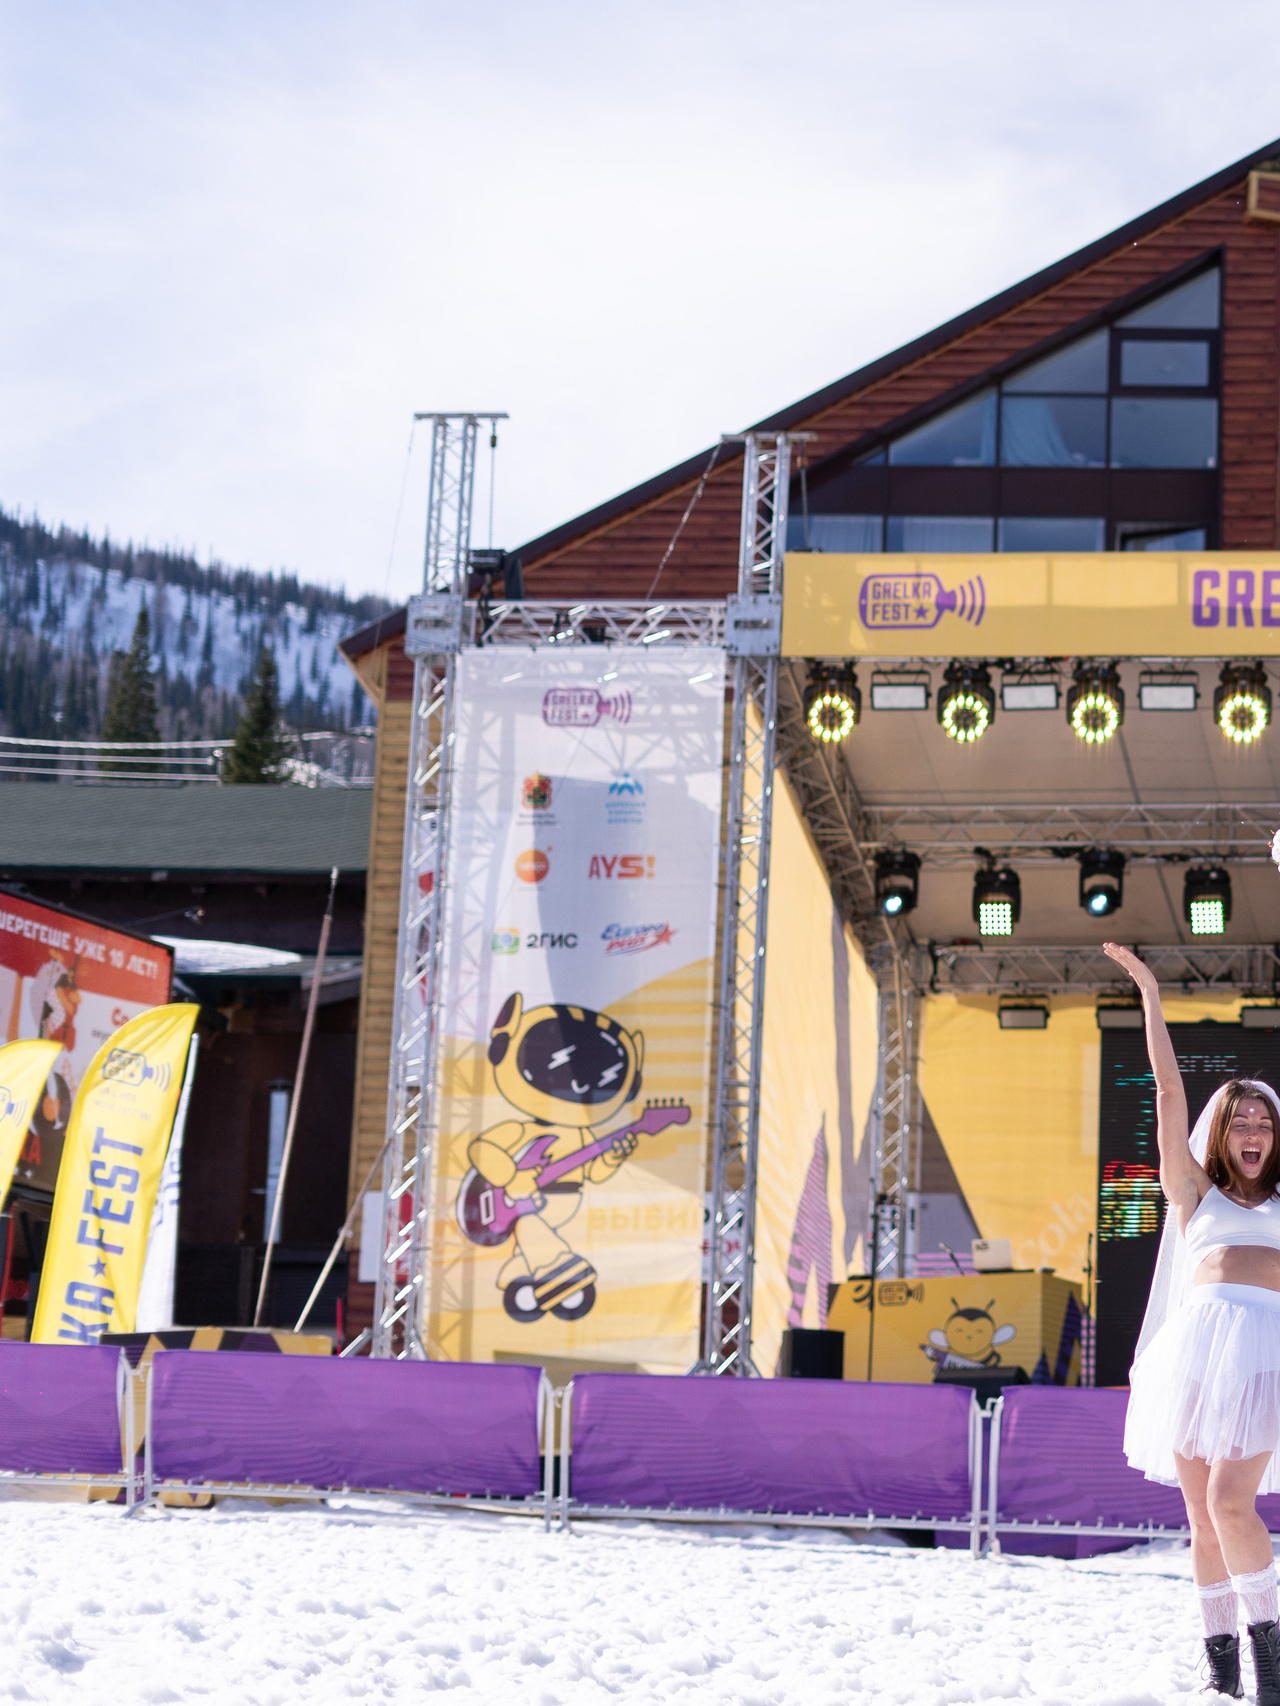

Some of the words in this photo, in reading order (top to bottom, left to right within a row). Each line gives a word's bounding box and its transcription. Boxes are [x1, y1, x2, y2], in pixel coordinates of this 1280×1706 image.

[872, 582, 932, 600] GRELKA
[871, 603, 911, 621] FEST
[526, 932, 578, 949] 2ГИС
[74, 935, 106, 963] УЖЕ
[109, 948, 125, 970] 10
[126, 954, 159, 980] ЛЕТ!
[76, 1126, 144, 1256] FEST
